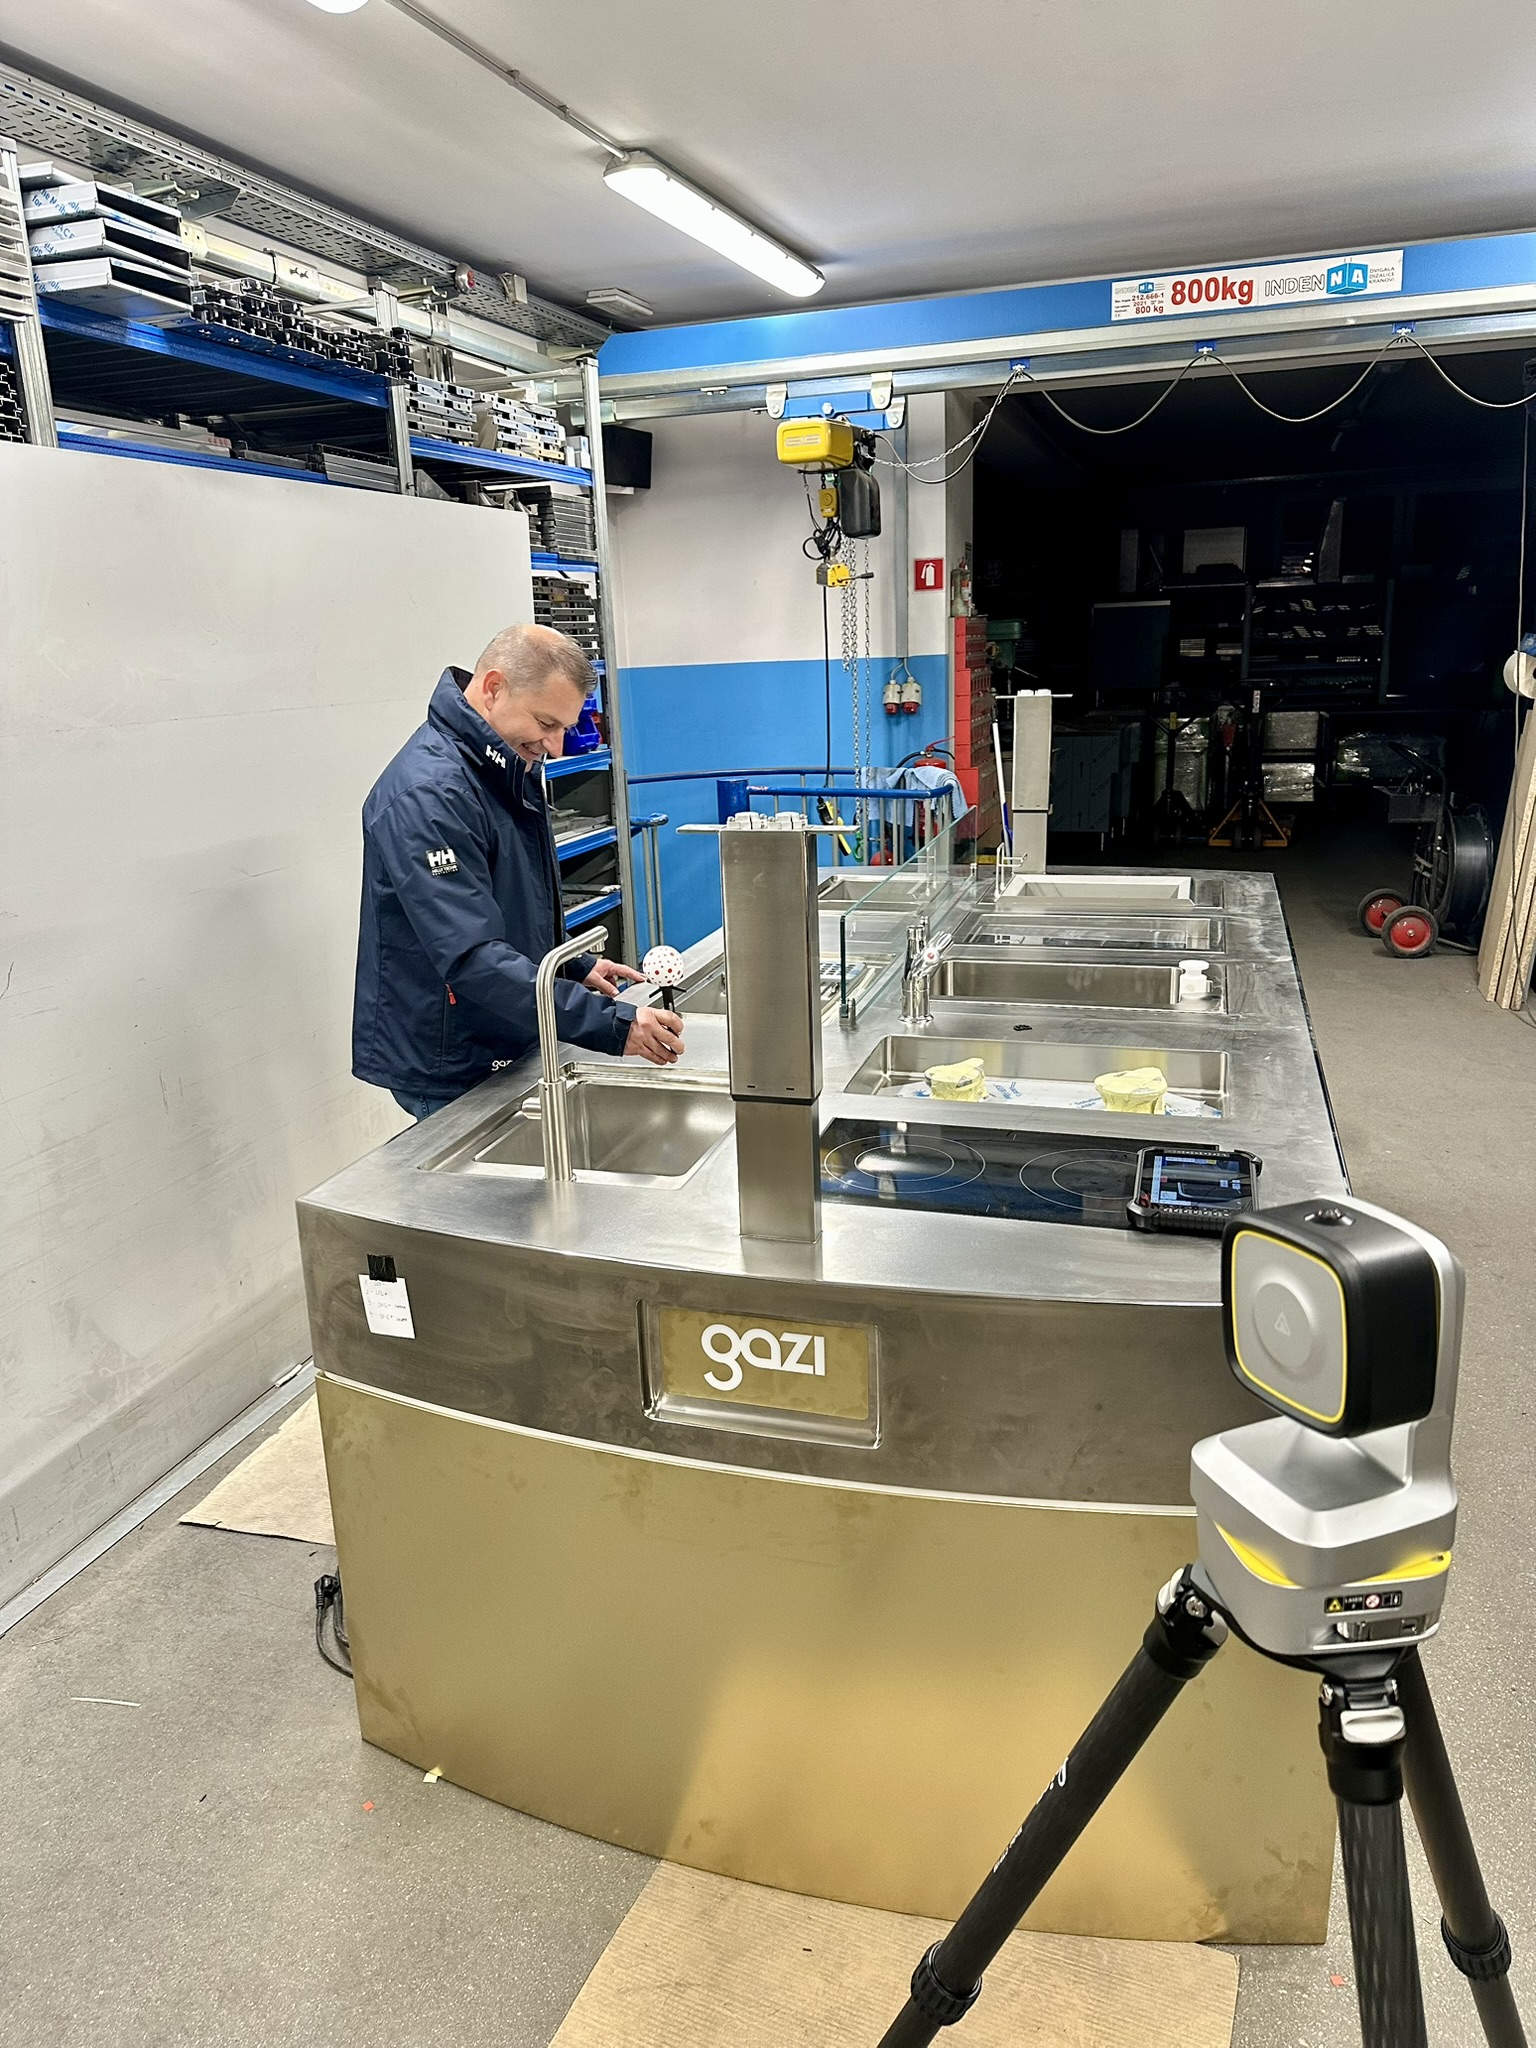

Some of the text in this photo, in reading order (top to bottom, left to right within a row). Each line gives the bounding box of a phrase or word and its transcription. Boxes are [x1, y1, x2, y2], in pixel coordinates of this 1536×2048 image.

[1369, 266, 1395, 274] DVIGALA
[1171, 276, 1254, 306] 800kg
[1135, 305, 1151, 315] 800
[1153, 304, 1164, 314] kg
[428, 848, 456, 867] HH
